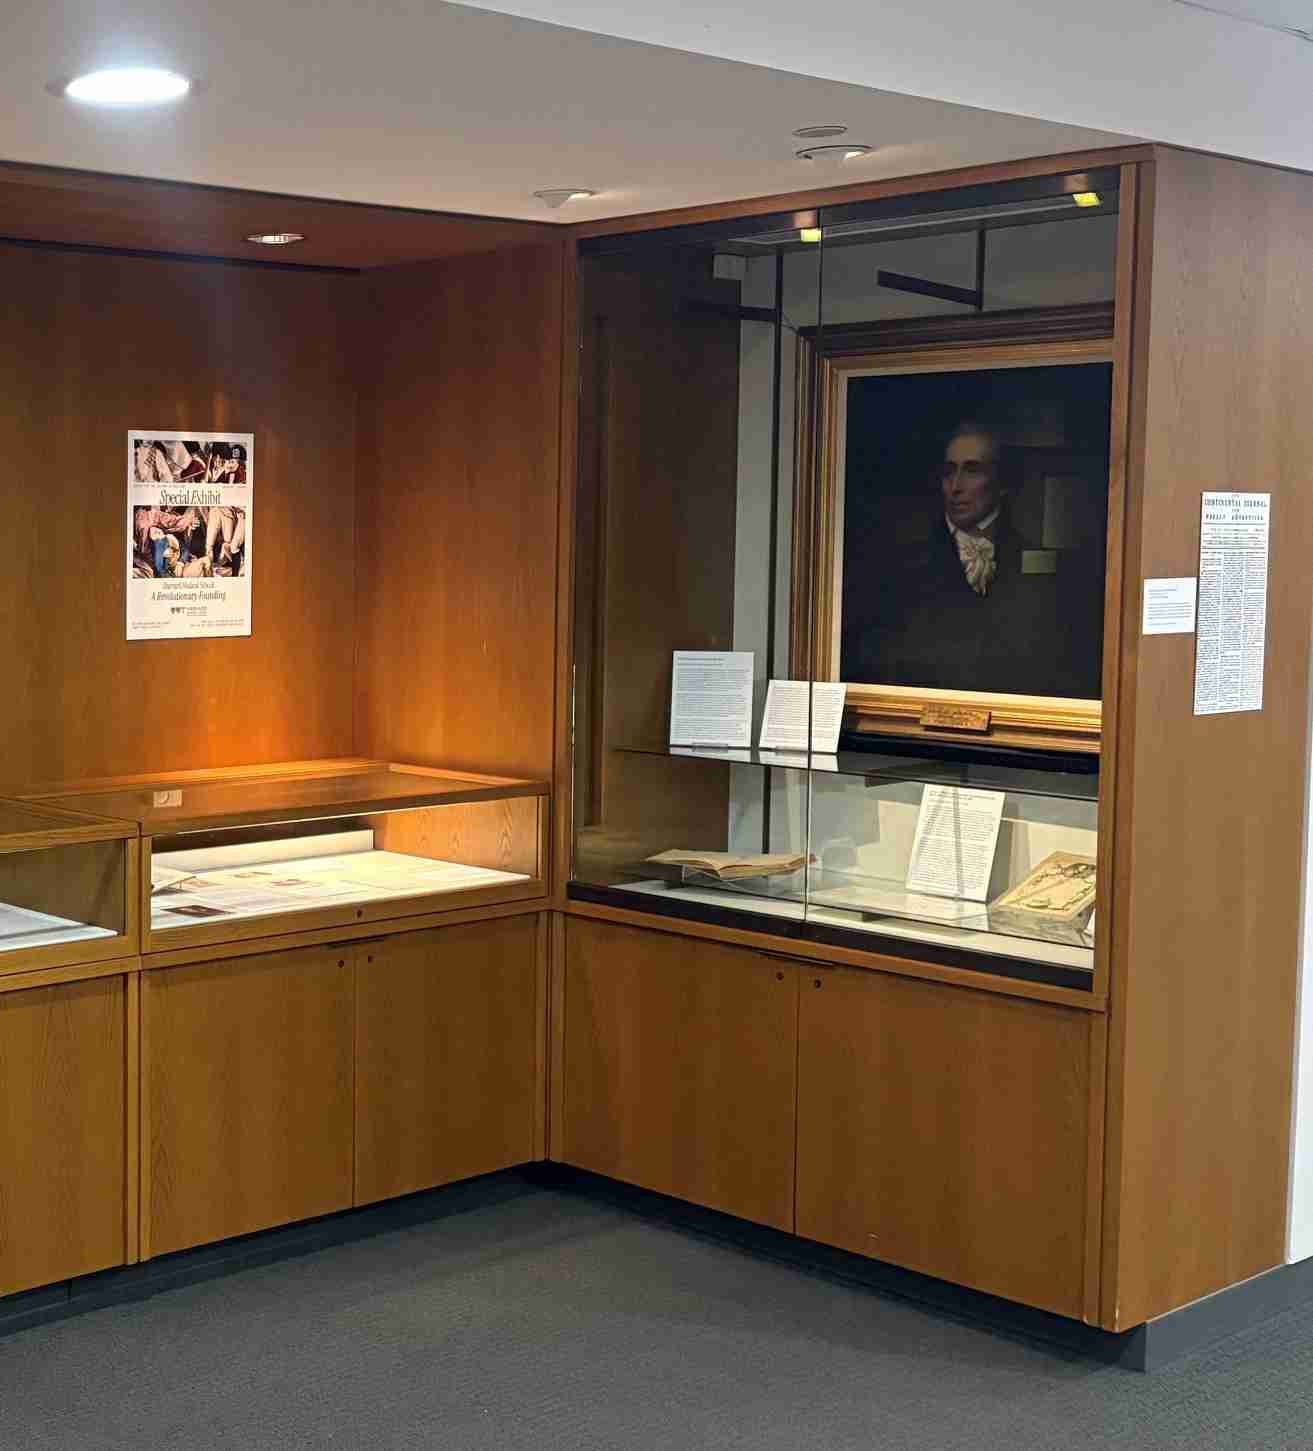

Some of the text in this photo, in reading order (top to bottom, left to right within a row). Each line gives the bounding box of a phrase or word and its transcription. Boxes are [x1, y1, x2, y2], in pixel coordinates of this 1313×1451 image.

[159, 488, 222, 505] Special Exhibit
[156, 591, 197, 602] Revolutionary
[198, 590, 227, 602] Founding
